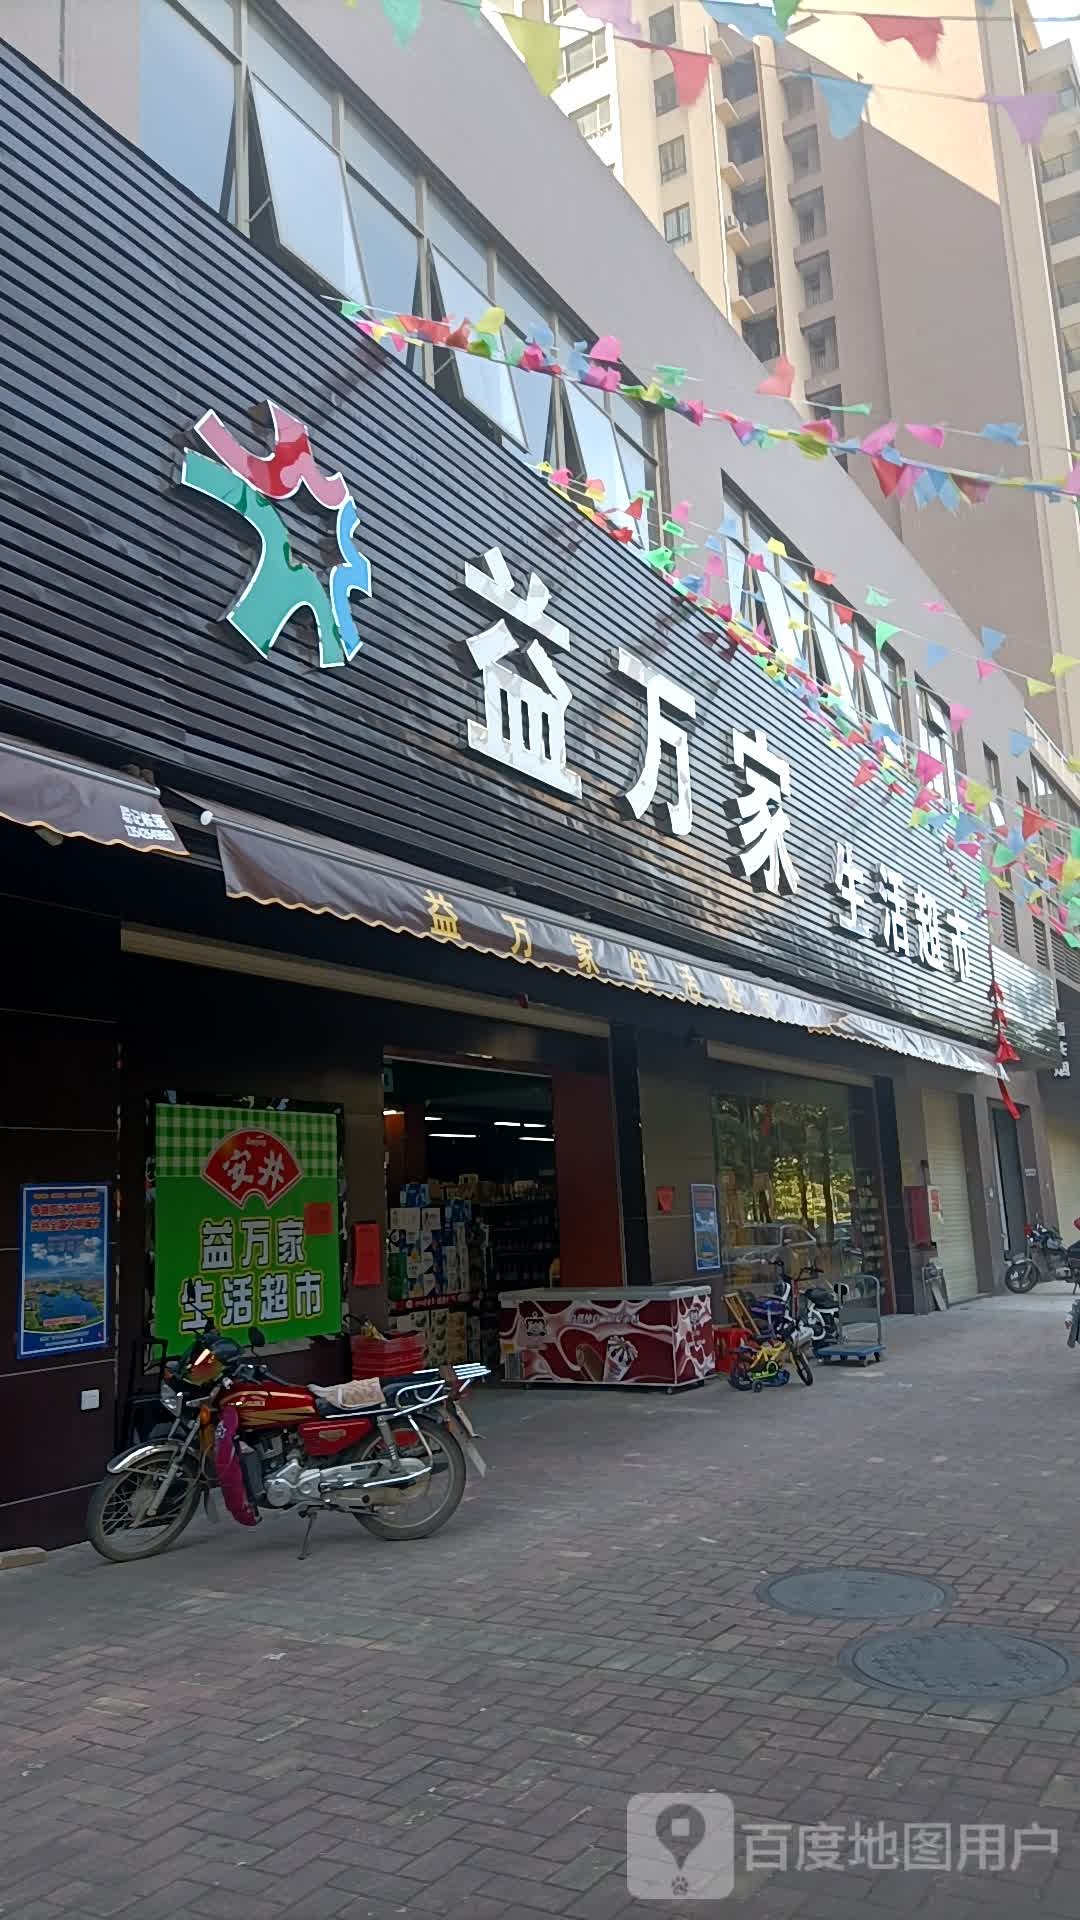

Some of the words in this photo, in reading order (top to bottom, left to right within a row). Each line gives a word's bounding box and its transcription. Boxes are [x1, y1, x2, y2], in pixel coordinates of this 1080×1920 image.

[463, 545, 801, 896] 益万家
[834, 838, 973, 983] 生活超市
[200, 1217, 305, 1271] 益万家
[180, 1269, 323, 1332] 生活超市
